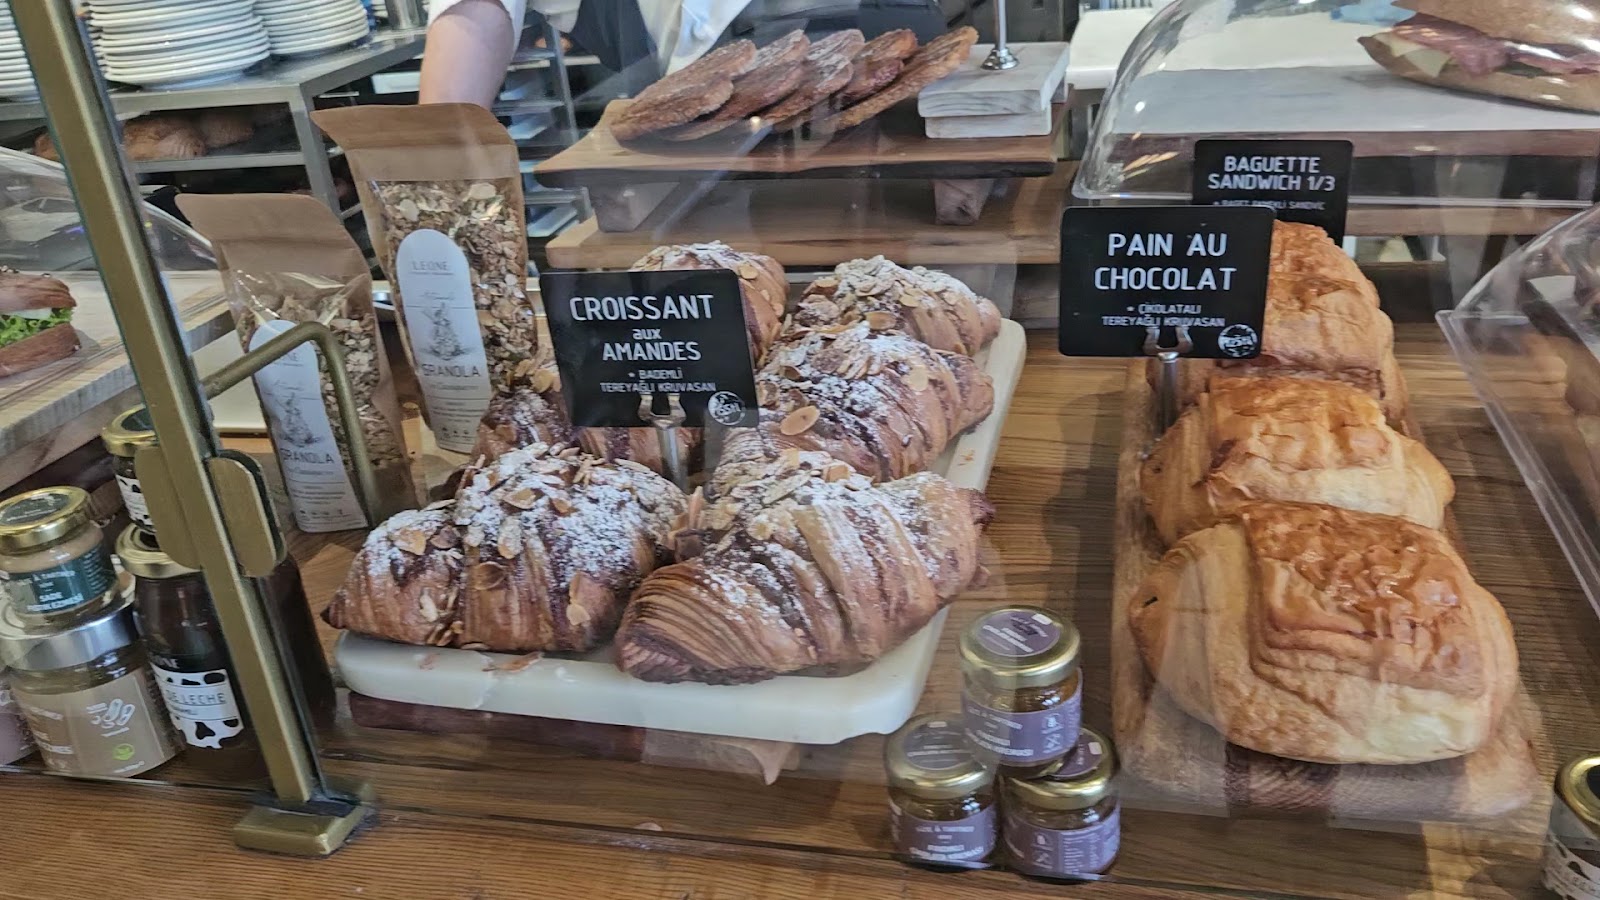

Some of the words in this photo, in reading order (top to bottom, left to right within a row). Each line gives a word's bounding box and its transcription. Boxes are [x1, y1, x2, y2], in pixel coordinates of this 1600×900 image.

[1224, 155, 1320, 173] BAGUETTE
[1208, 174, 1300, 191] SANDWICH
[1307, 175, 1336, 191] 1/3
[1107, 233, 1173, 256] PAIN
[1186, 233, 1228, 256] AU
[1094, 267, 1237, 291] CHOCOLAT
[569, 294, 714, 321] CROISSANT
[632, 328, 662, 340] aux
[602, 341, 701, 361] AMANDES
[421, 363, 481, 377] GRANOLA
[658, 382, 716, 392] KRUVASAN
[279, 447, 335, 464] GRANOLA
[183, 691, 227, 705] LECHE
